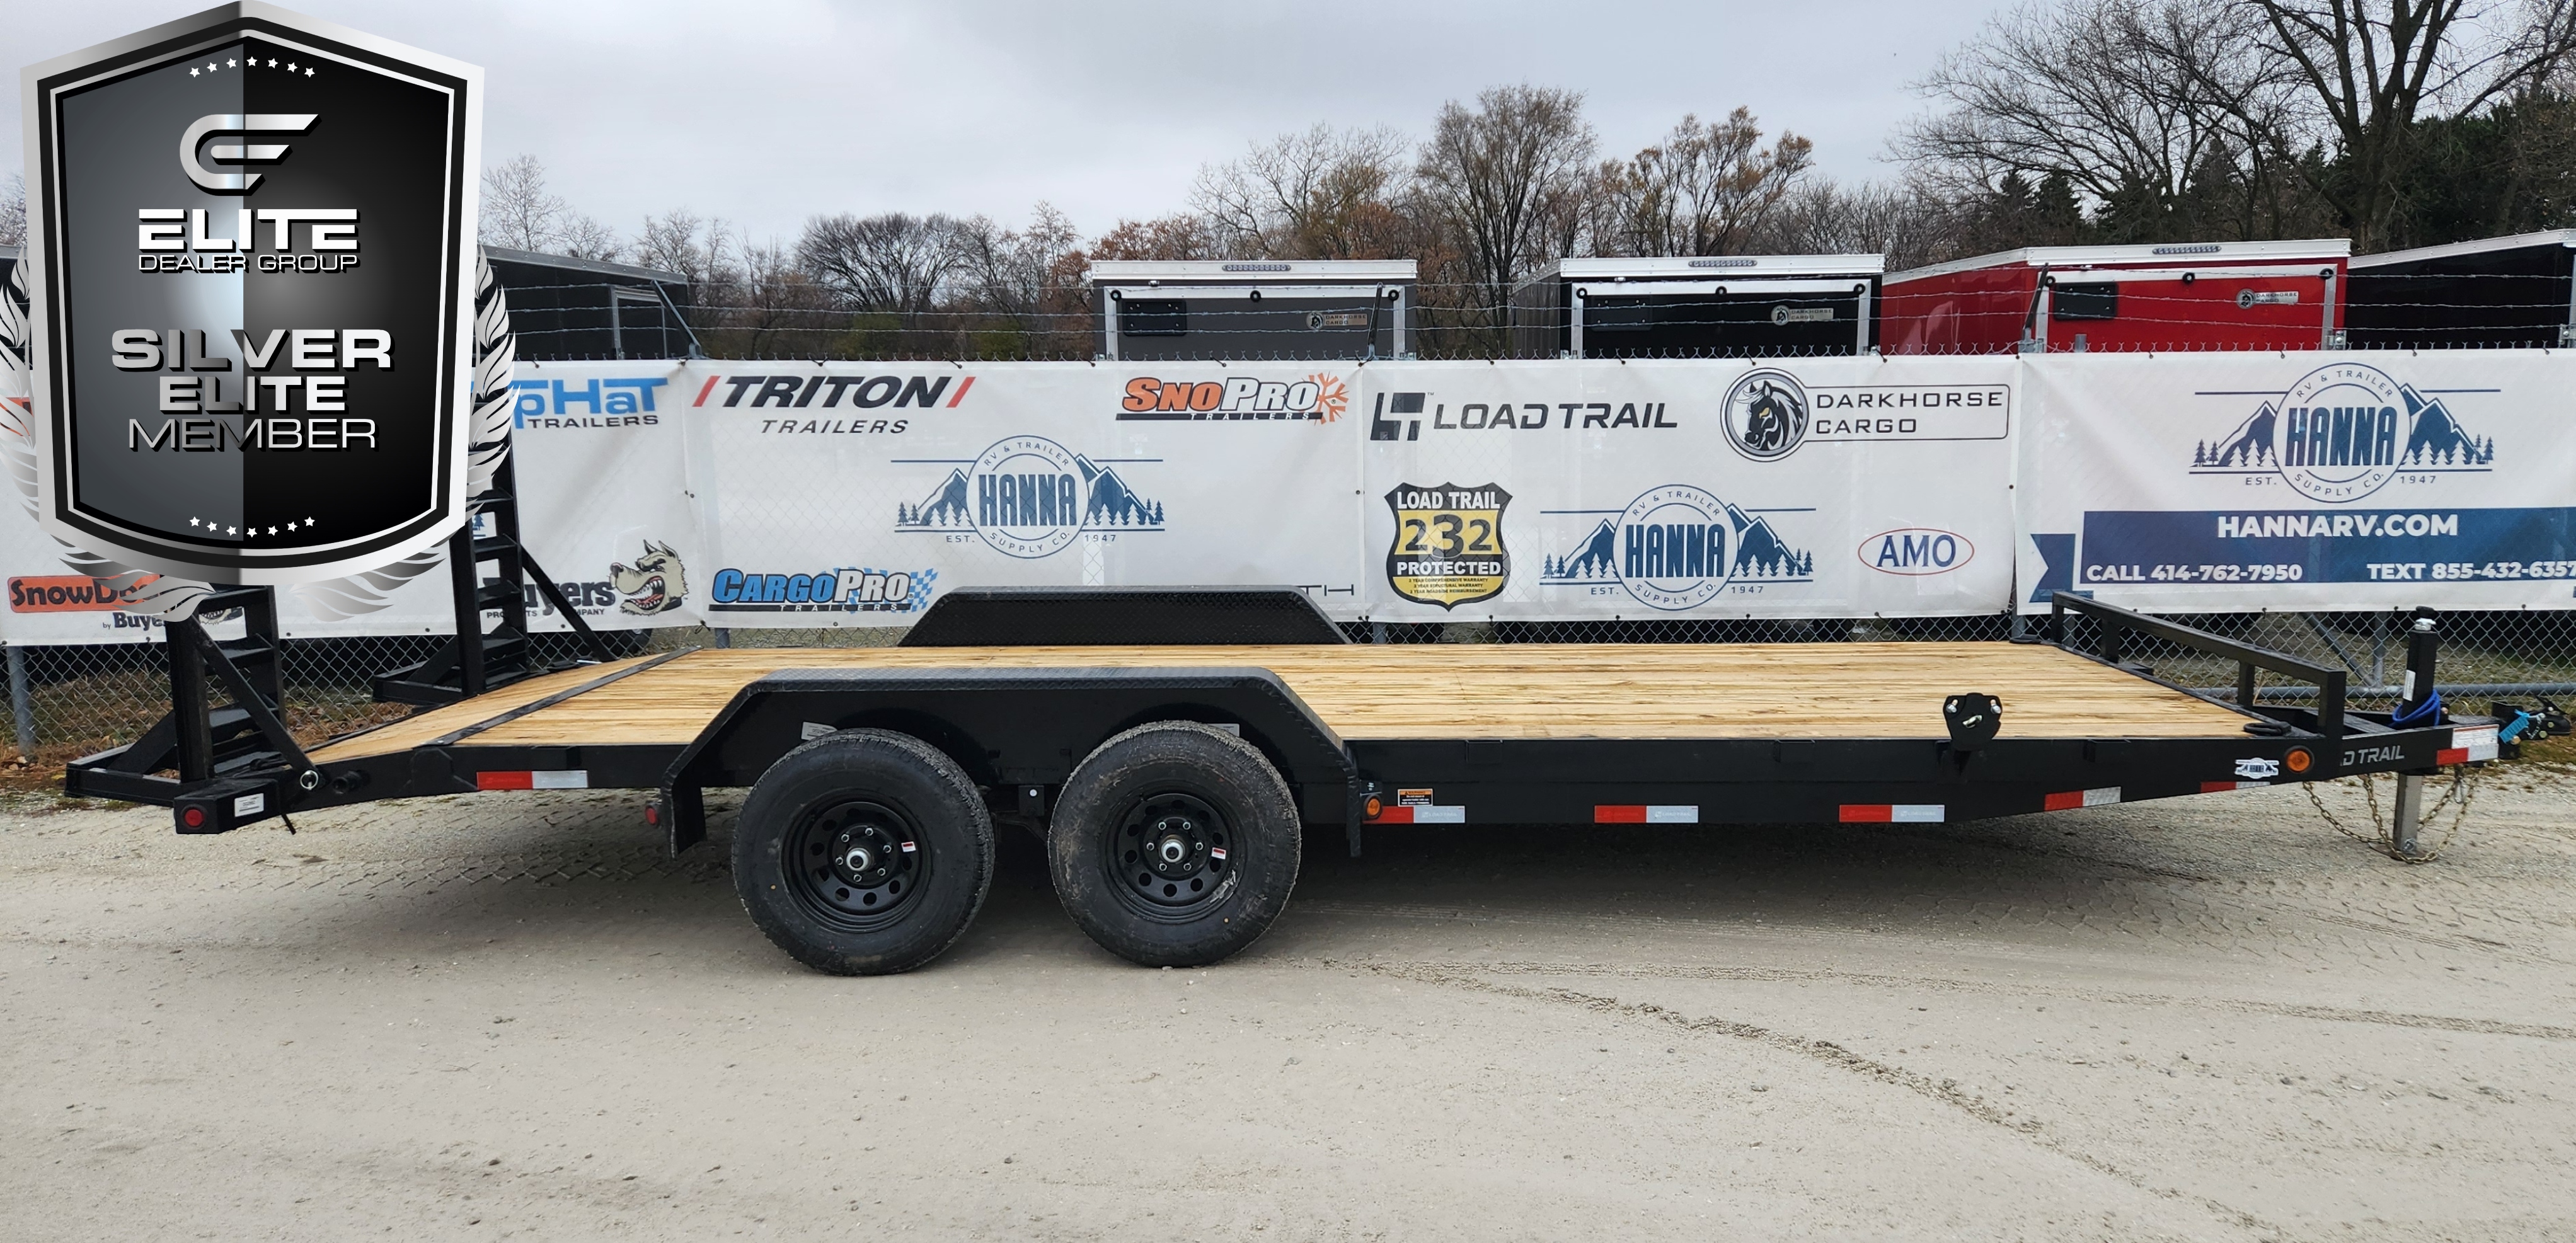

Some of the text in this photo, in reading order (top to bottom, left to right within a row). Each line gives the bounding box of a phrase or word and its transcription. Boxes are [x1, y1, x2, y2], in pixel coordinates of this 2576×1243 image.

[722, 376, 953, 409] TRITON
[2296, 382, 2312, 398] RV
[2337, 370, 2393, 397] TRAILER
[1817, 391, 2003, 409] DARKHORSE
[527, 415, 658, 428] TRAILERS
[761, 420, 909, 433] TRAILERS
[1433, 403, 1678, 430] LOAD TRAIL
[1815, 418, 1917, 434] CARGO
[2285, 406, 2397, 466] HANNA
[984, 452, 997, 466] RV
[1017, 442, 1069, 466] TRAILER
[2245, 476, 2437, 485] EST. 1947
[2295, 473, 2384, 496] SUPPLY CO.
[978, 474, 1077, 526] HANNA
[1397, 491, 1500, 509] LOAD TRAIL
[1632, 502, 1645, 516] RV
[1667, 491, 1720, 516] TRAILER
[2217, 514, 2458, 537] HANNARV.COM
[990, 532, 1070, 553] SUPPLY CO.
[1405, 514, 1492, 559] 232
[1625, 524, 1725, 578] HANNA
[1875, 534, 1957, 568] AMO
[1397, 561, 1501, 575] PROTECTED
[2087, 564, 2303, 581] CALL 414-762-7950
[2367, 561, 2576, 580] TEXT 855-432-6357
[1635, 584, 1716, 604] SUPPLY CO.
[780, 604, 897, 612] TRAILERS
[2359, 745, 2405, 764] TRAIL
